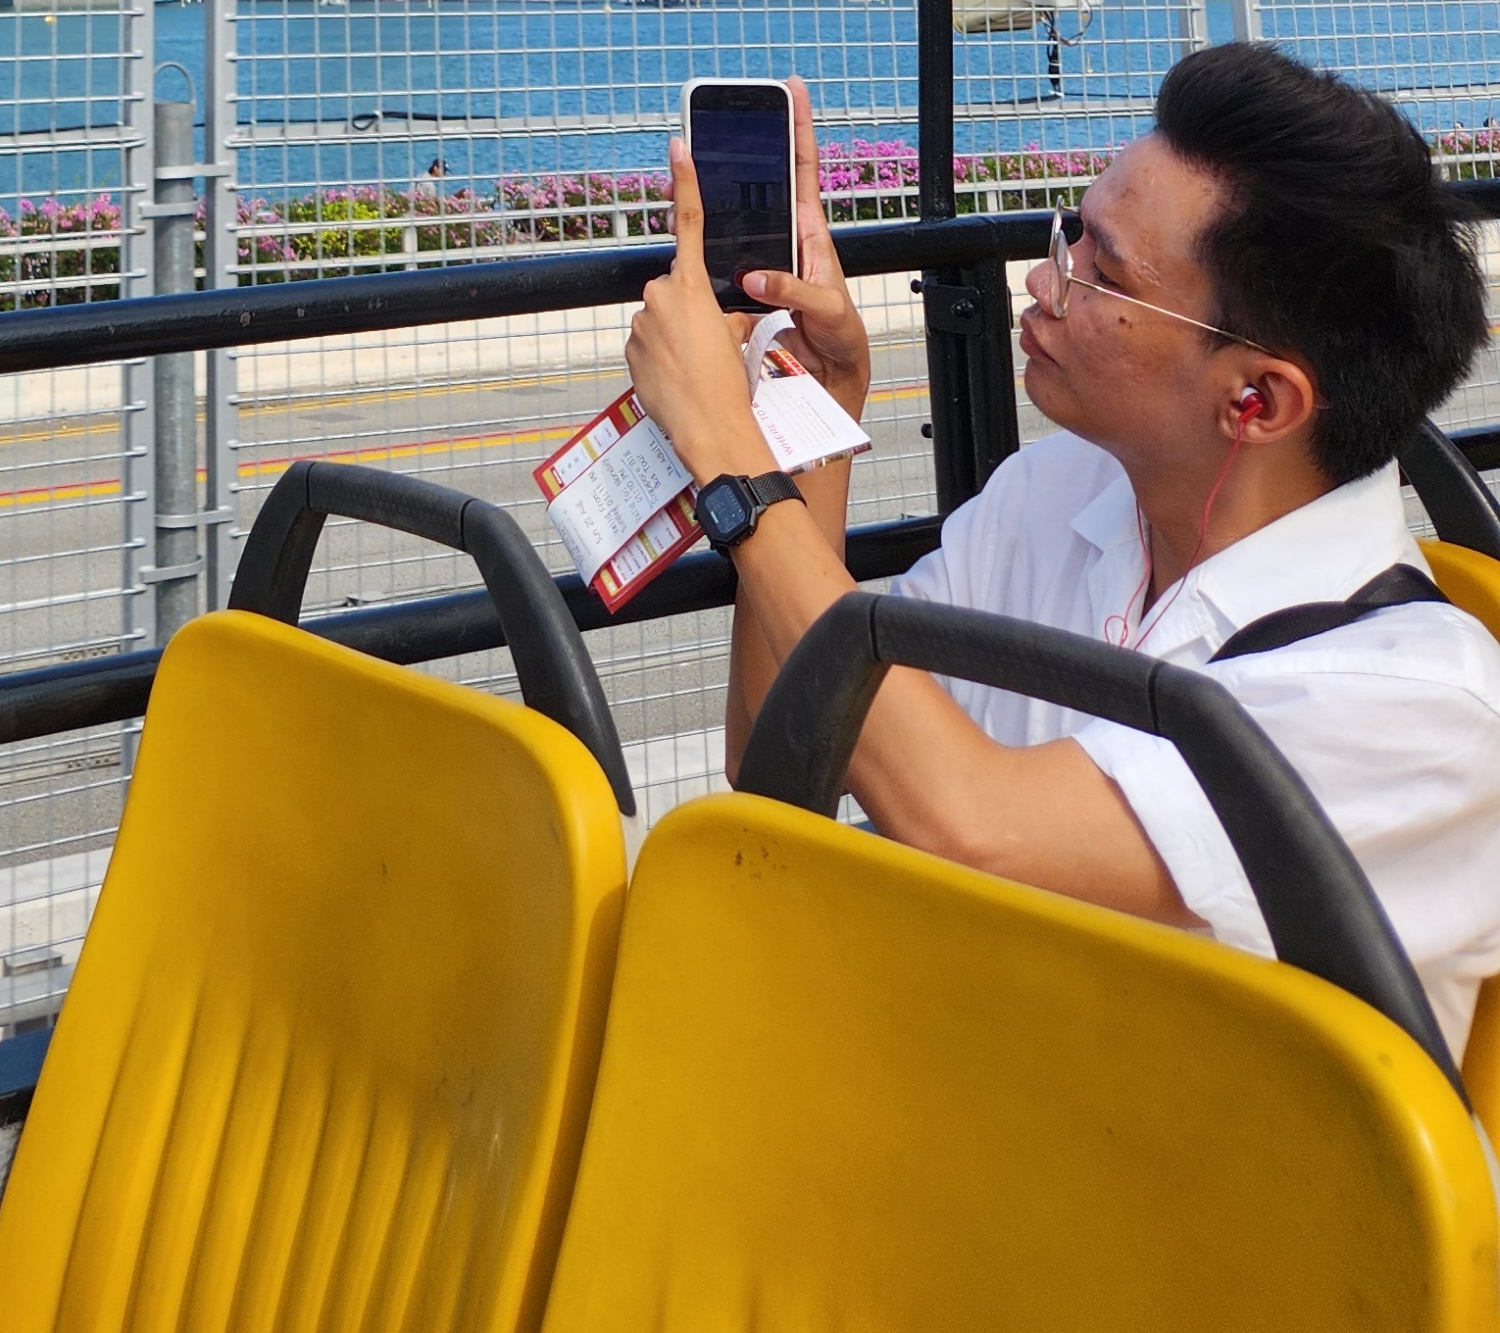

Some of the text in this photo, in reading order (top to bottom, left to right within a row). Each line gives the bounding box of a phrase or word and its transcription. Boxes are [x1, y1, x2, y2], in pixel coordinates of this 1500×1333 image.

[756, 409, 767, 420] TO
[649, 440, 666, 464] Adult
[637, 454, 661, 489] Bus Tour
[585, 517, 593, 528] 20
[591, 529, 603, 544] Sun
